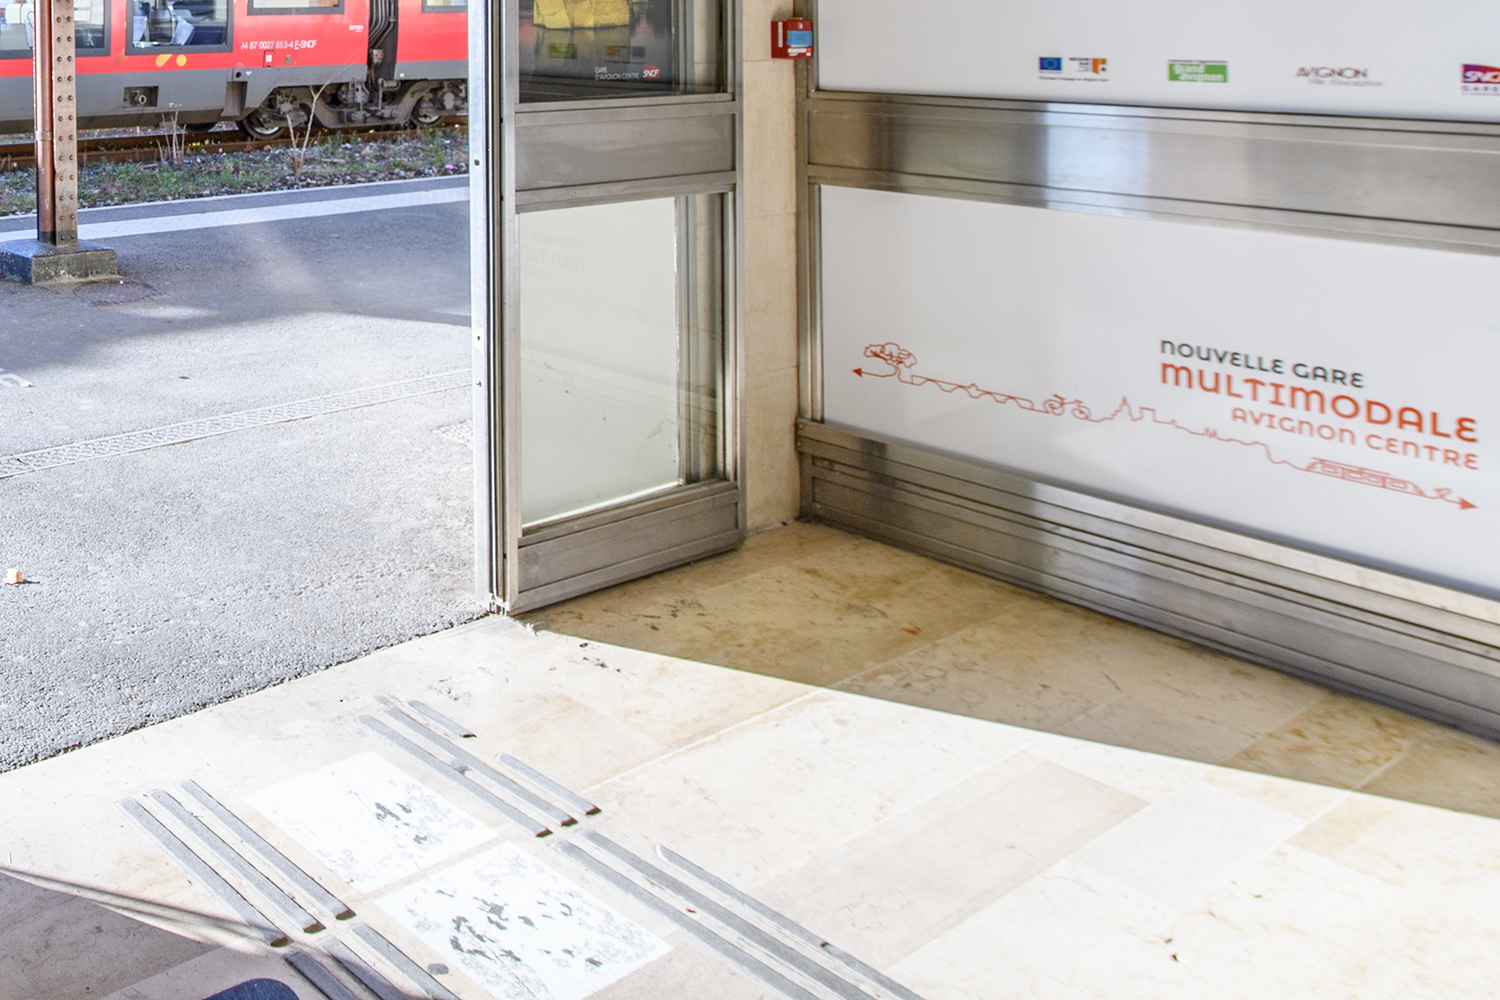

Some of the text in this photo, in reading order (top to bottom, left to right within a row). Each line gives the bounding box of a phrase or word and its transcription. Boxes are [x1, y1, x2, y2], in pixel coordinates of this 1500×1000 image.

[642, 69, 659, 78] SNCF
[1295, 66, 1368, 79] AVIGNON
[1160, 340, 1364, 389] NOUVELLE GARE
[1161, 361, 1479, 443] MULTIMODALE
[1231, 407, 1479, 471] AVIGNON CENTRE
